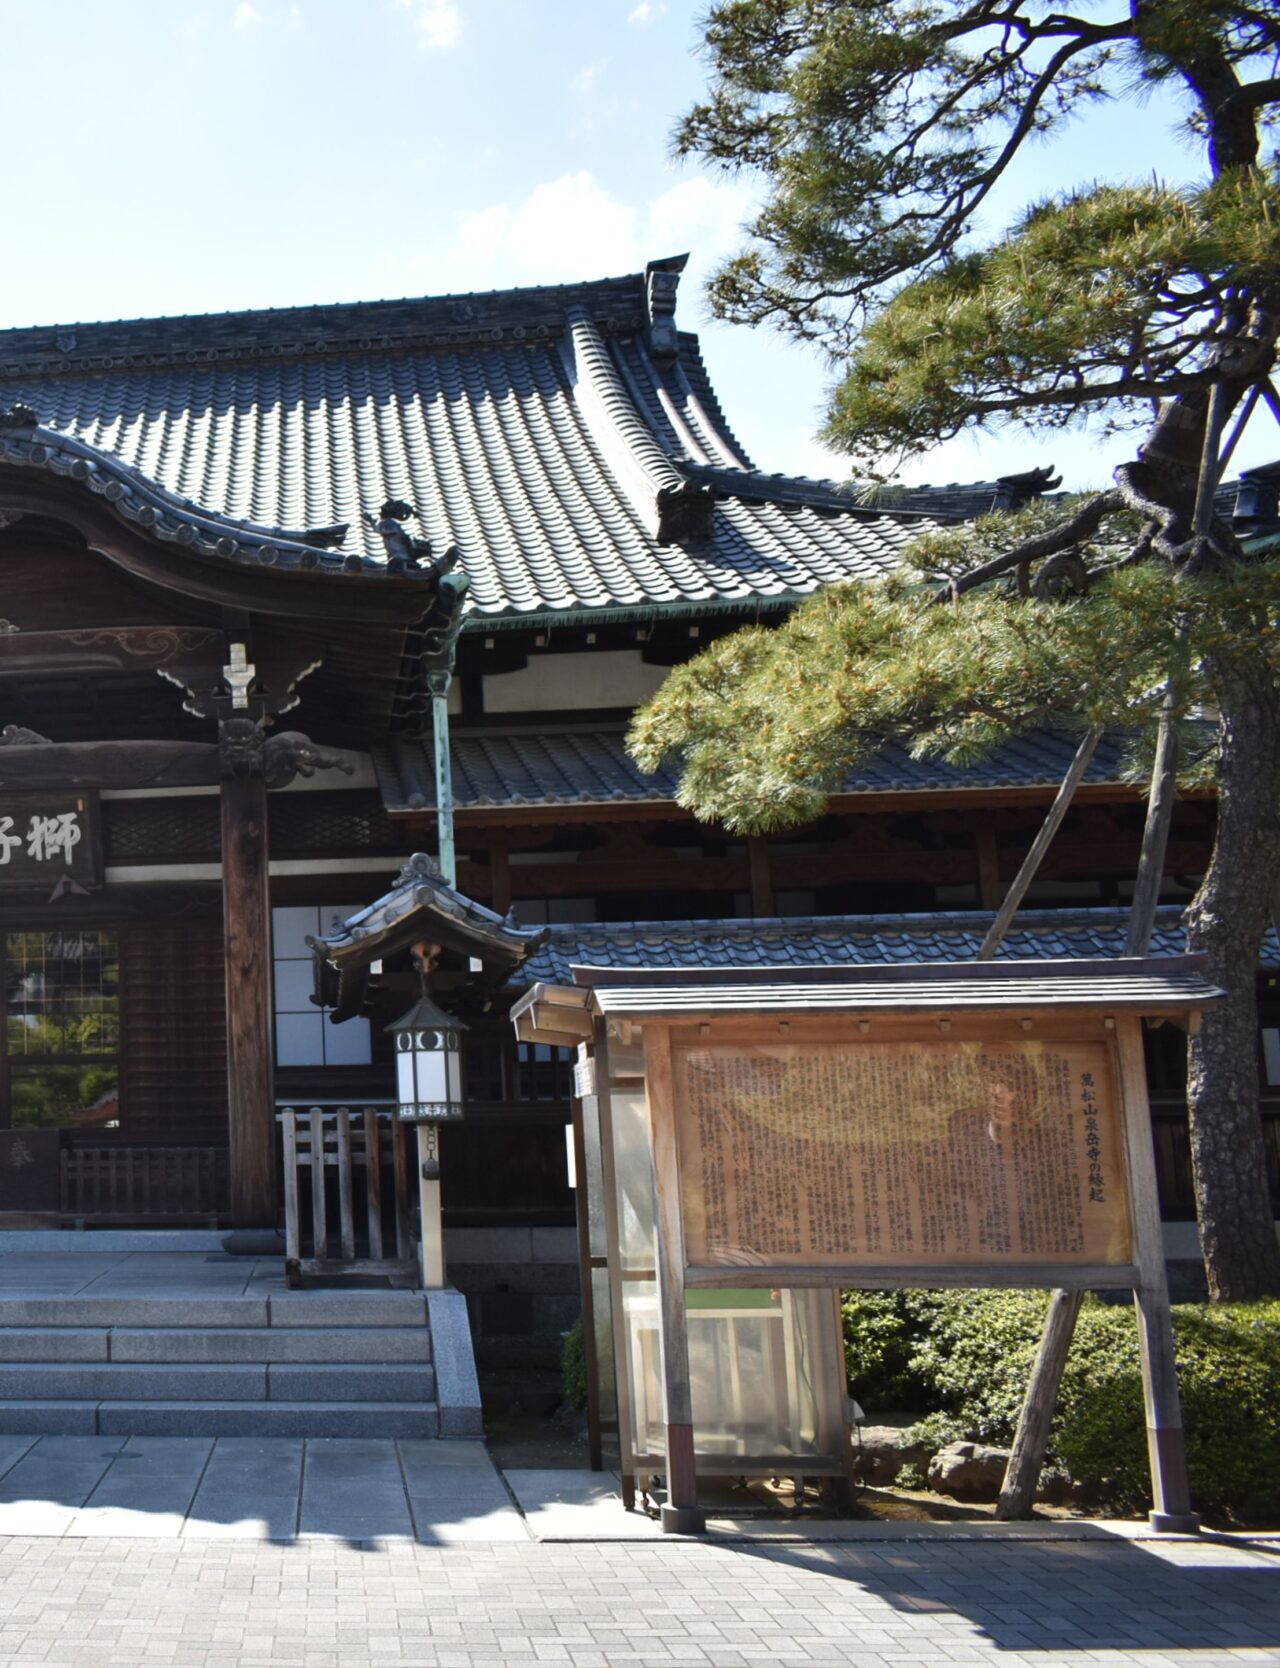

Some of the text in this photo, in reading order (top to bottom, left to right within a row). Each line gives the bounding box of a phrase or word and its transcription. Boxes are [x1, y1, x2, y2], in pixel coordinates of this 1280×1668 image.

[1080, 1072, 1106, 1203] 萬松山泉岳寺の縁起
